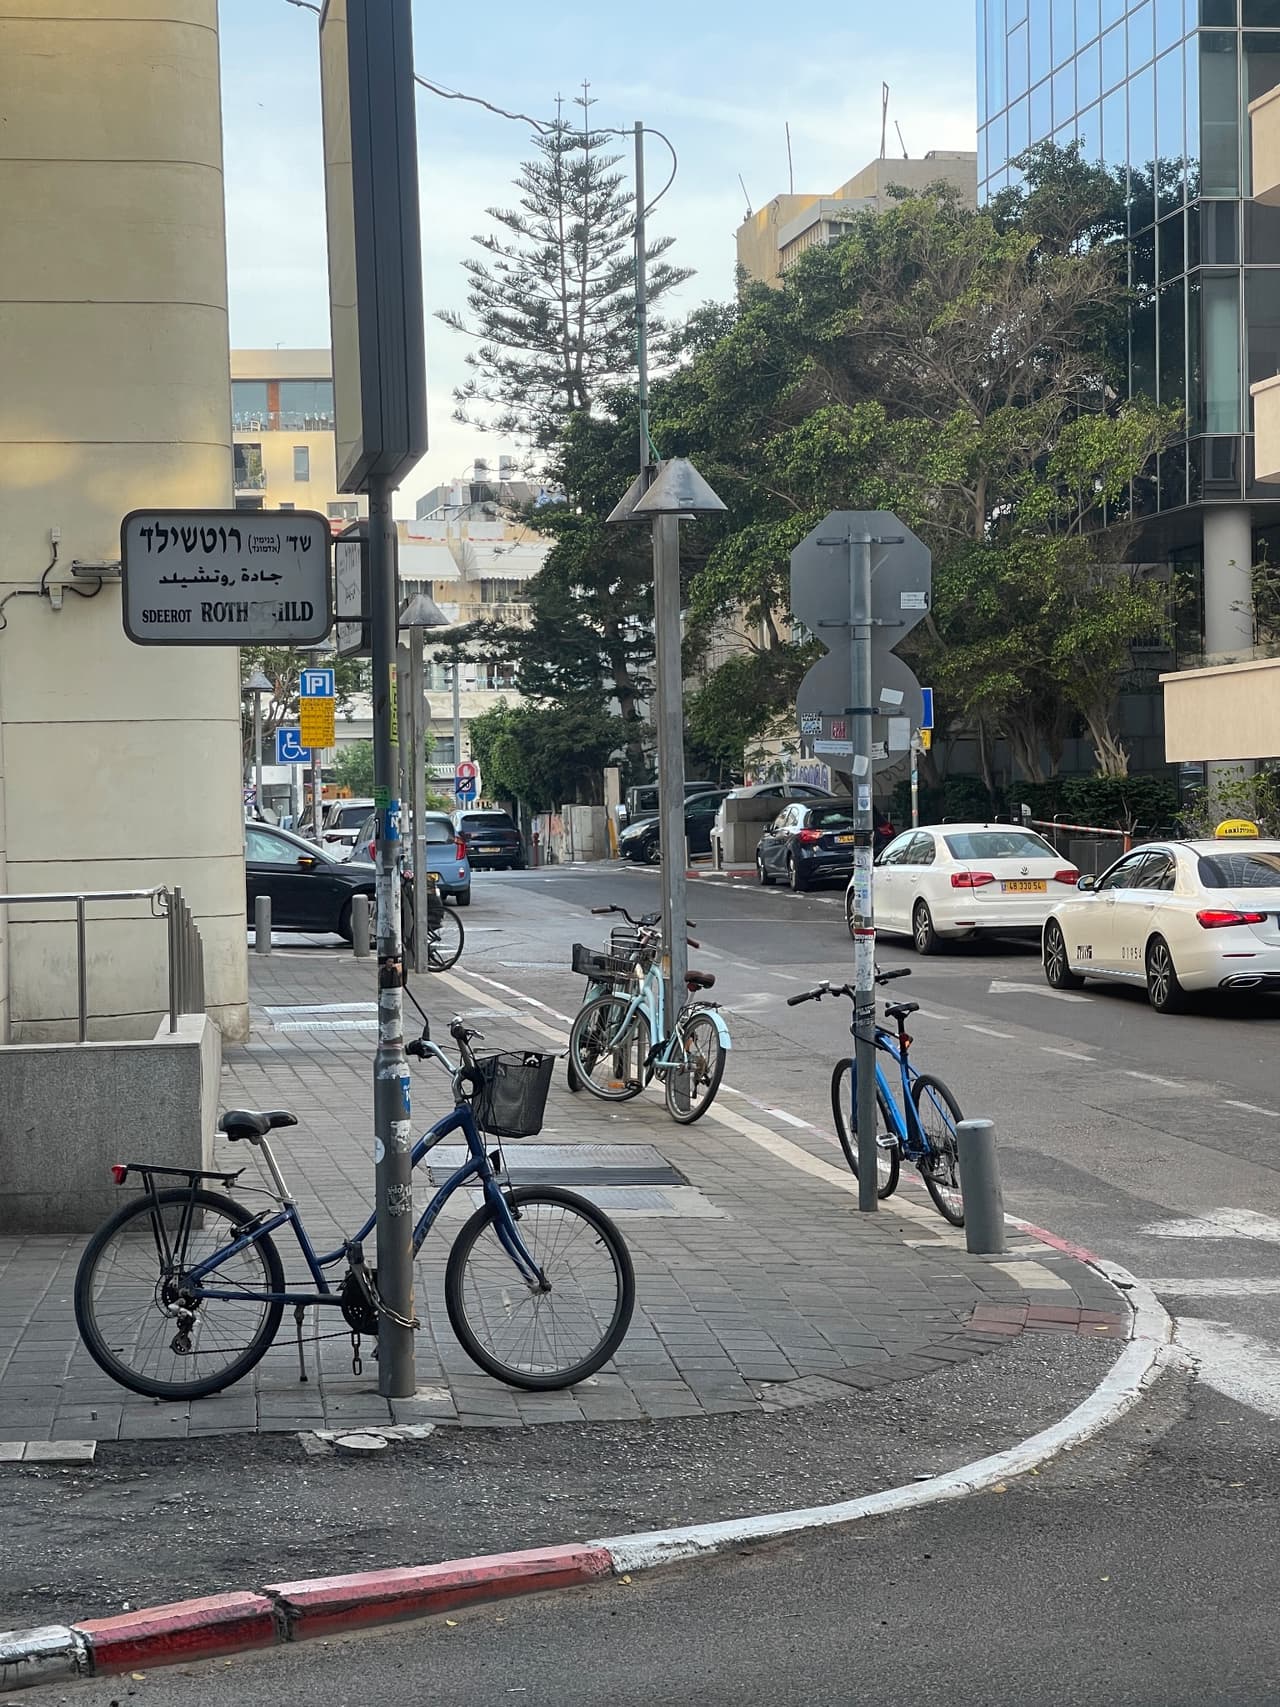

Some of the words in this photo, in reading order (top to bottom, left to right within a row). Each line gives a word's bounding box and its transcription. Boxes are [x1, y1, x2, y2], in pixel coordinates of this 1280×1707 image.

[139, 521, 242, 554] רוטשילד
[159, 566, 236, 588] روتشيلد
[241, 567, 283, 586] جادة
[142, 609, 192, 623] SDEEROT
[200, 601, 314, 622] ROTHILD
